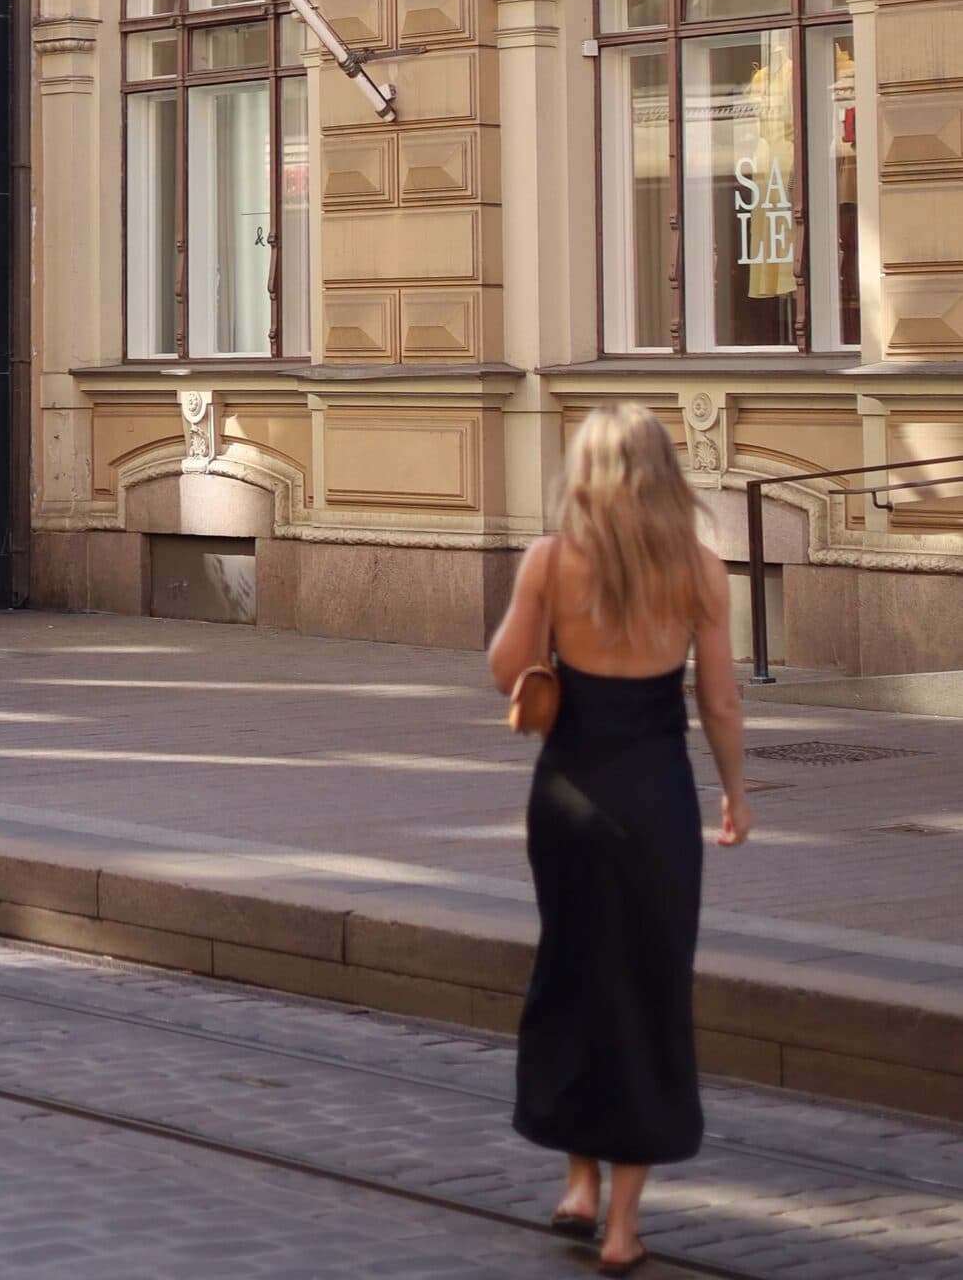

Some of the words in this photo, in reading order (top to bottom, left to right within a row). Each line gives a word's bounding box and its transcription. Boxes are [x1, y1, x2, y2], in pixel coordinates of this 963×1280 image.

[734, 157, 792, 211] SA
[254, 226, 266, 247] &
[737, 210, 794, 265] LE
